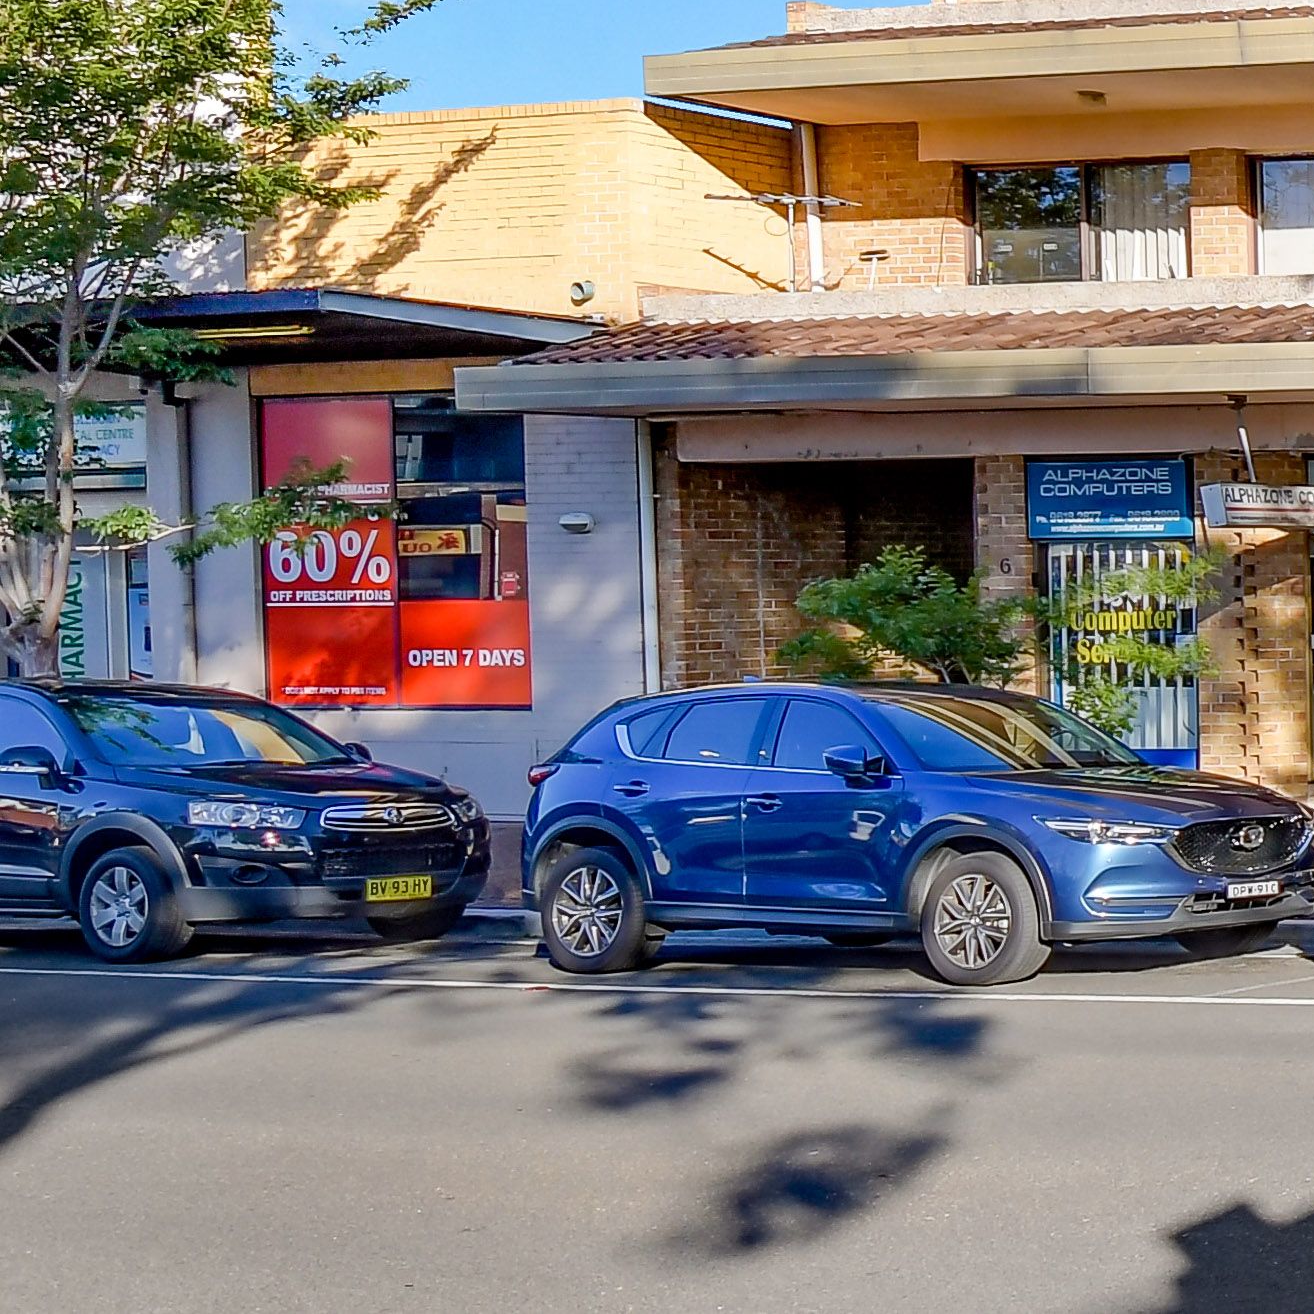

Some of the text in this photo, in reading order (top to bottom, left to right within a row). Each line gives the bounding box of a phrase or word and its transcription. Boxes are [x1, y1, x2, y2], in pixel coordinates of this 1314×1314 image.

[96, 428, 134, 440] CENTRE
[1043, 468, 1170, 482] ALPHAZONE
[1040, 482, 1172, 496] COMPUTERS
[1225, 487, 1294, 505] ALPHAZONE
[269, 529, 391, 584] 60%
[1000, 557, 1011, 574] 6
[270, 590, 392, 602] OFF PRESCRIPTIONS
[1071, 607, 1176, 635] Computer
[408, 649, 525, 667] OPEN 7 DAYS
[370, 878, 428, 895] BV 93 HY
